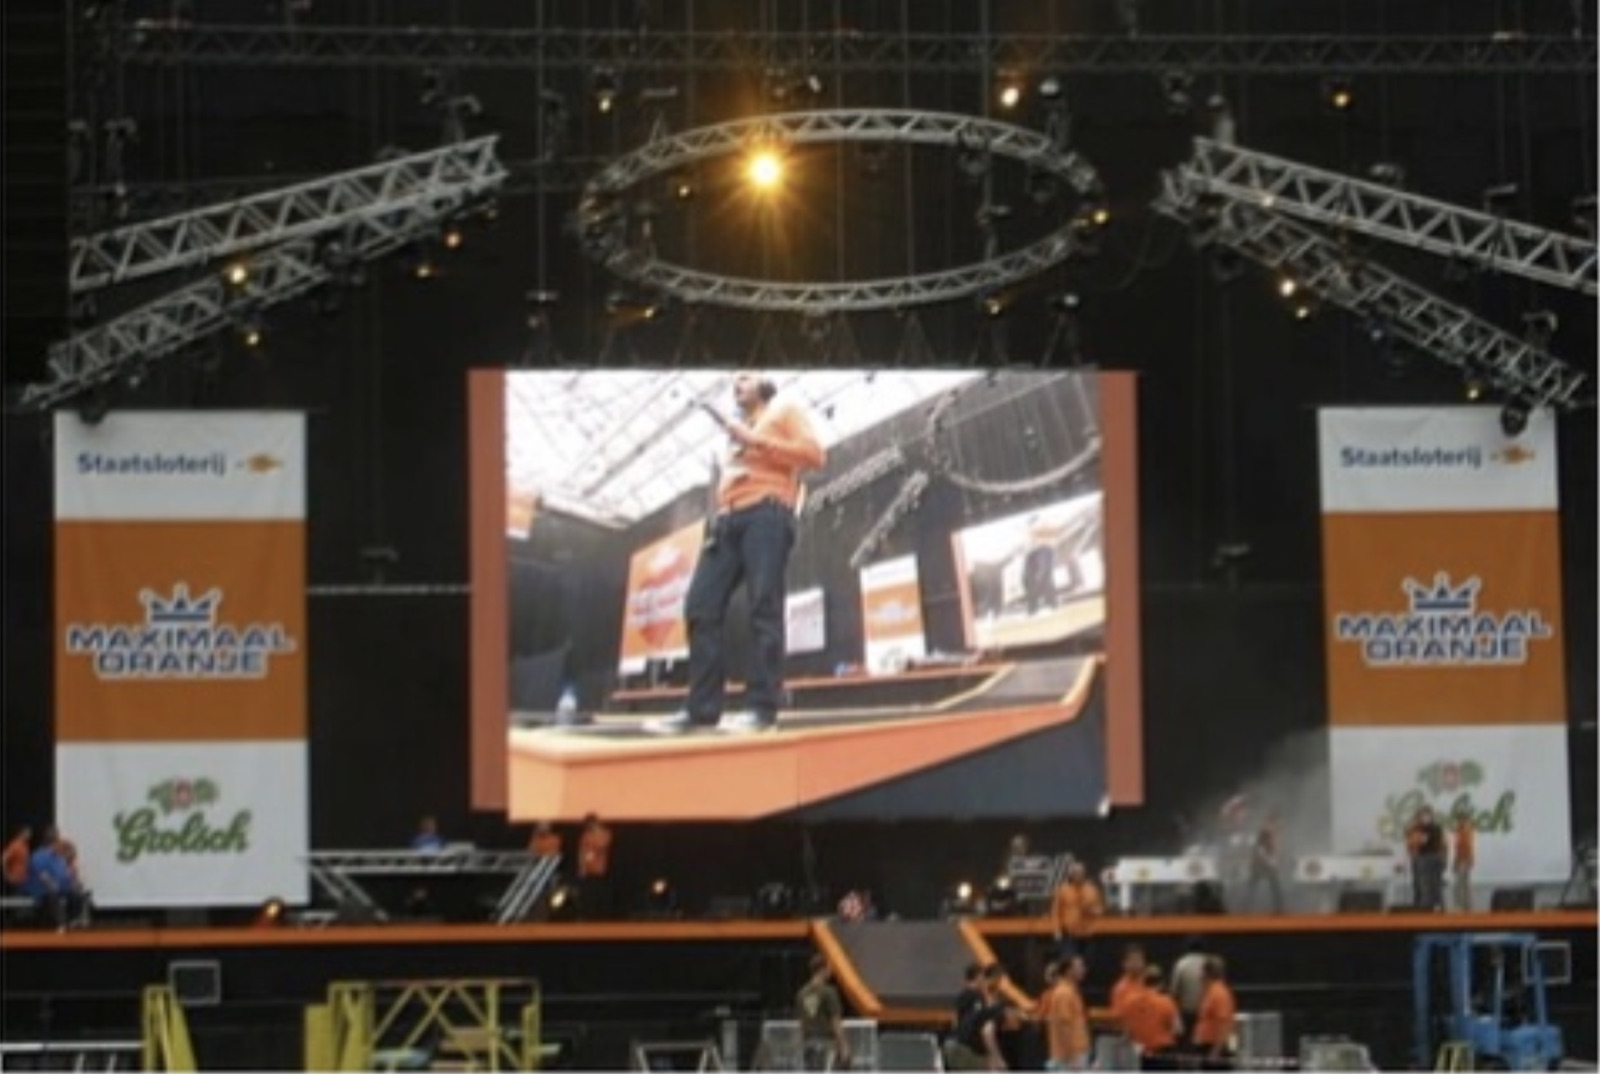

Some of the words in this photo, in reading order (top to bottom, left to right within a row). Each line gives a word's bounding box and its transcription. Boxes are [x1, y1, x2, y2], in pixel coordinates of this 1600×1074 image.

[78, 453, 227, 477] Staatsloterij
[1339, 446, 1481, 469] Staatsloterij
[68, 625, 294, 651] MAXIMAAL
[1337, 613, 1552, 638] MAXIMAAL
[1364, 636, 1524, 662] ORANJE
[98, 650, 263, 675] ORANJE
[1386, 789, 1515, 841] Glsch
[113, 808, 252, 865] Grolsch
